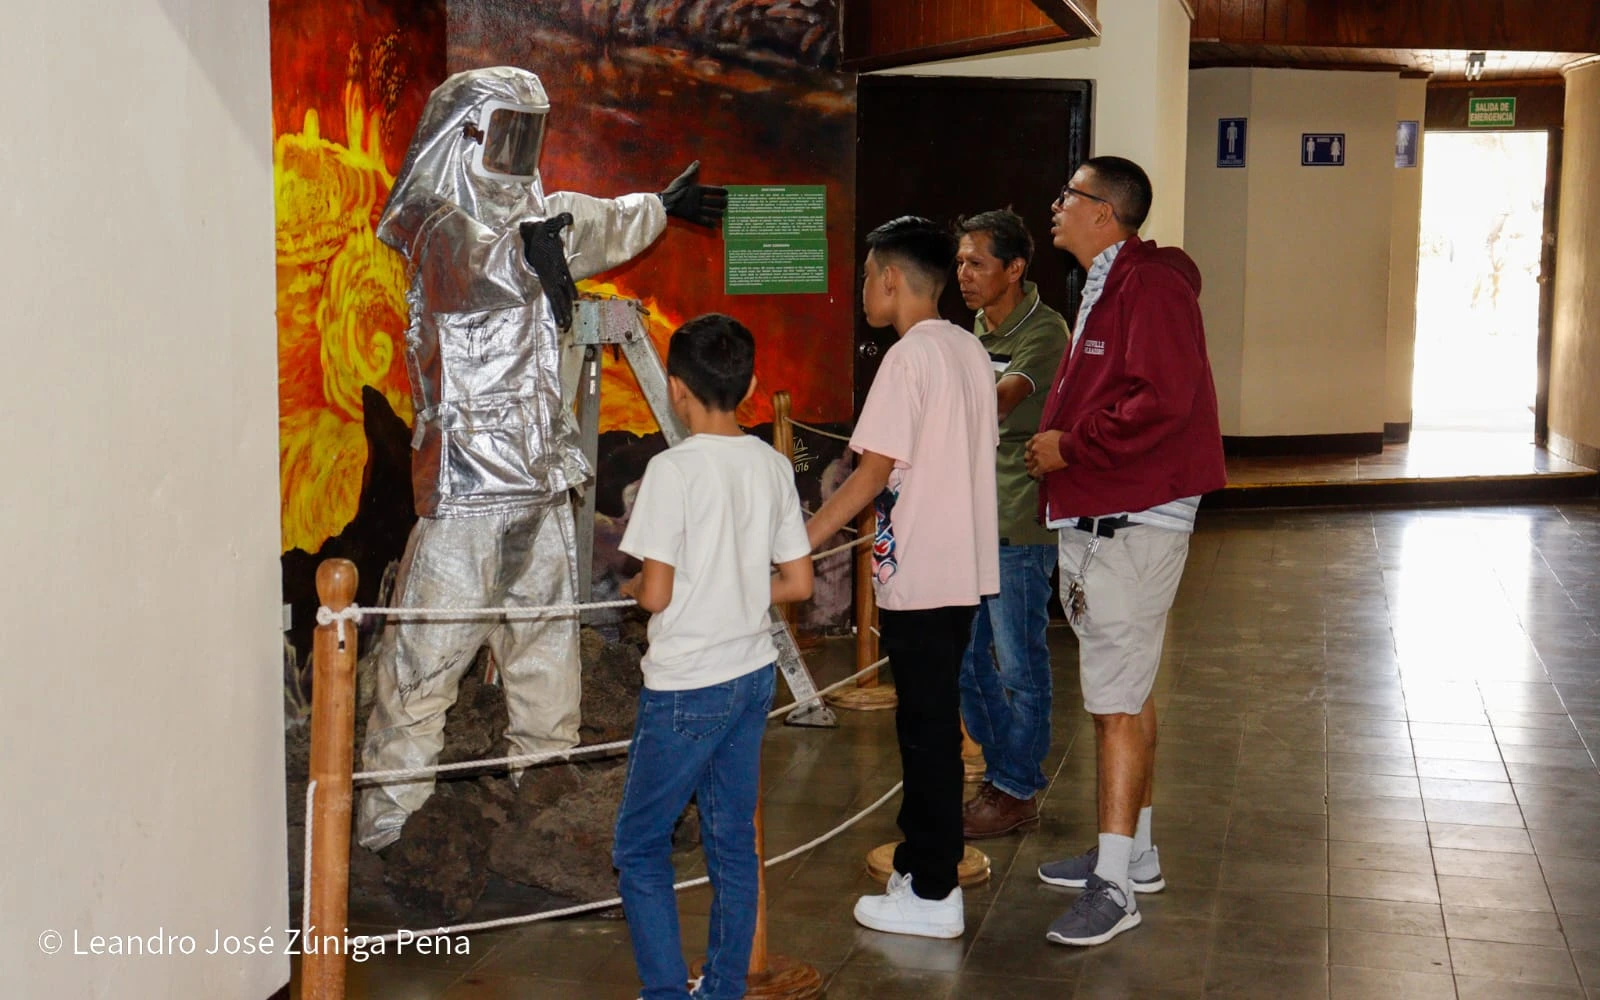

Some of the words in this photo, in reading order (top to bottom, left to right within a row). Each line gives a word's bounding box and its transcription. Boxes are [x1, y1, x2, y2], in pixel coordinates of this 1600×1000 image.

[1475, 102, 1499, 112] SALIDA
[1500, 102, 1510, 112] DE
[1470, 112, 1513, 121] EMERGENCIA
